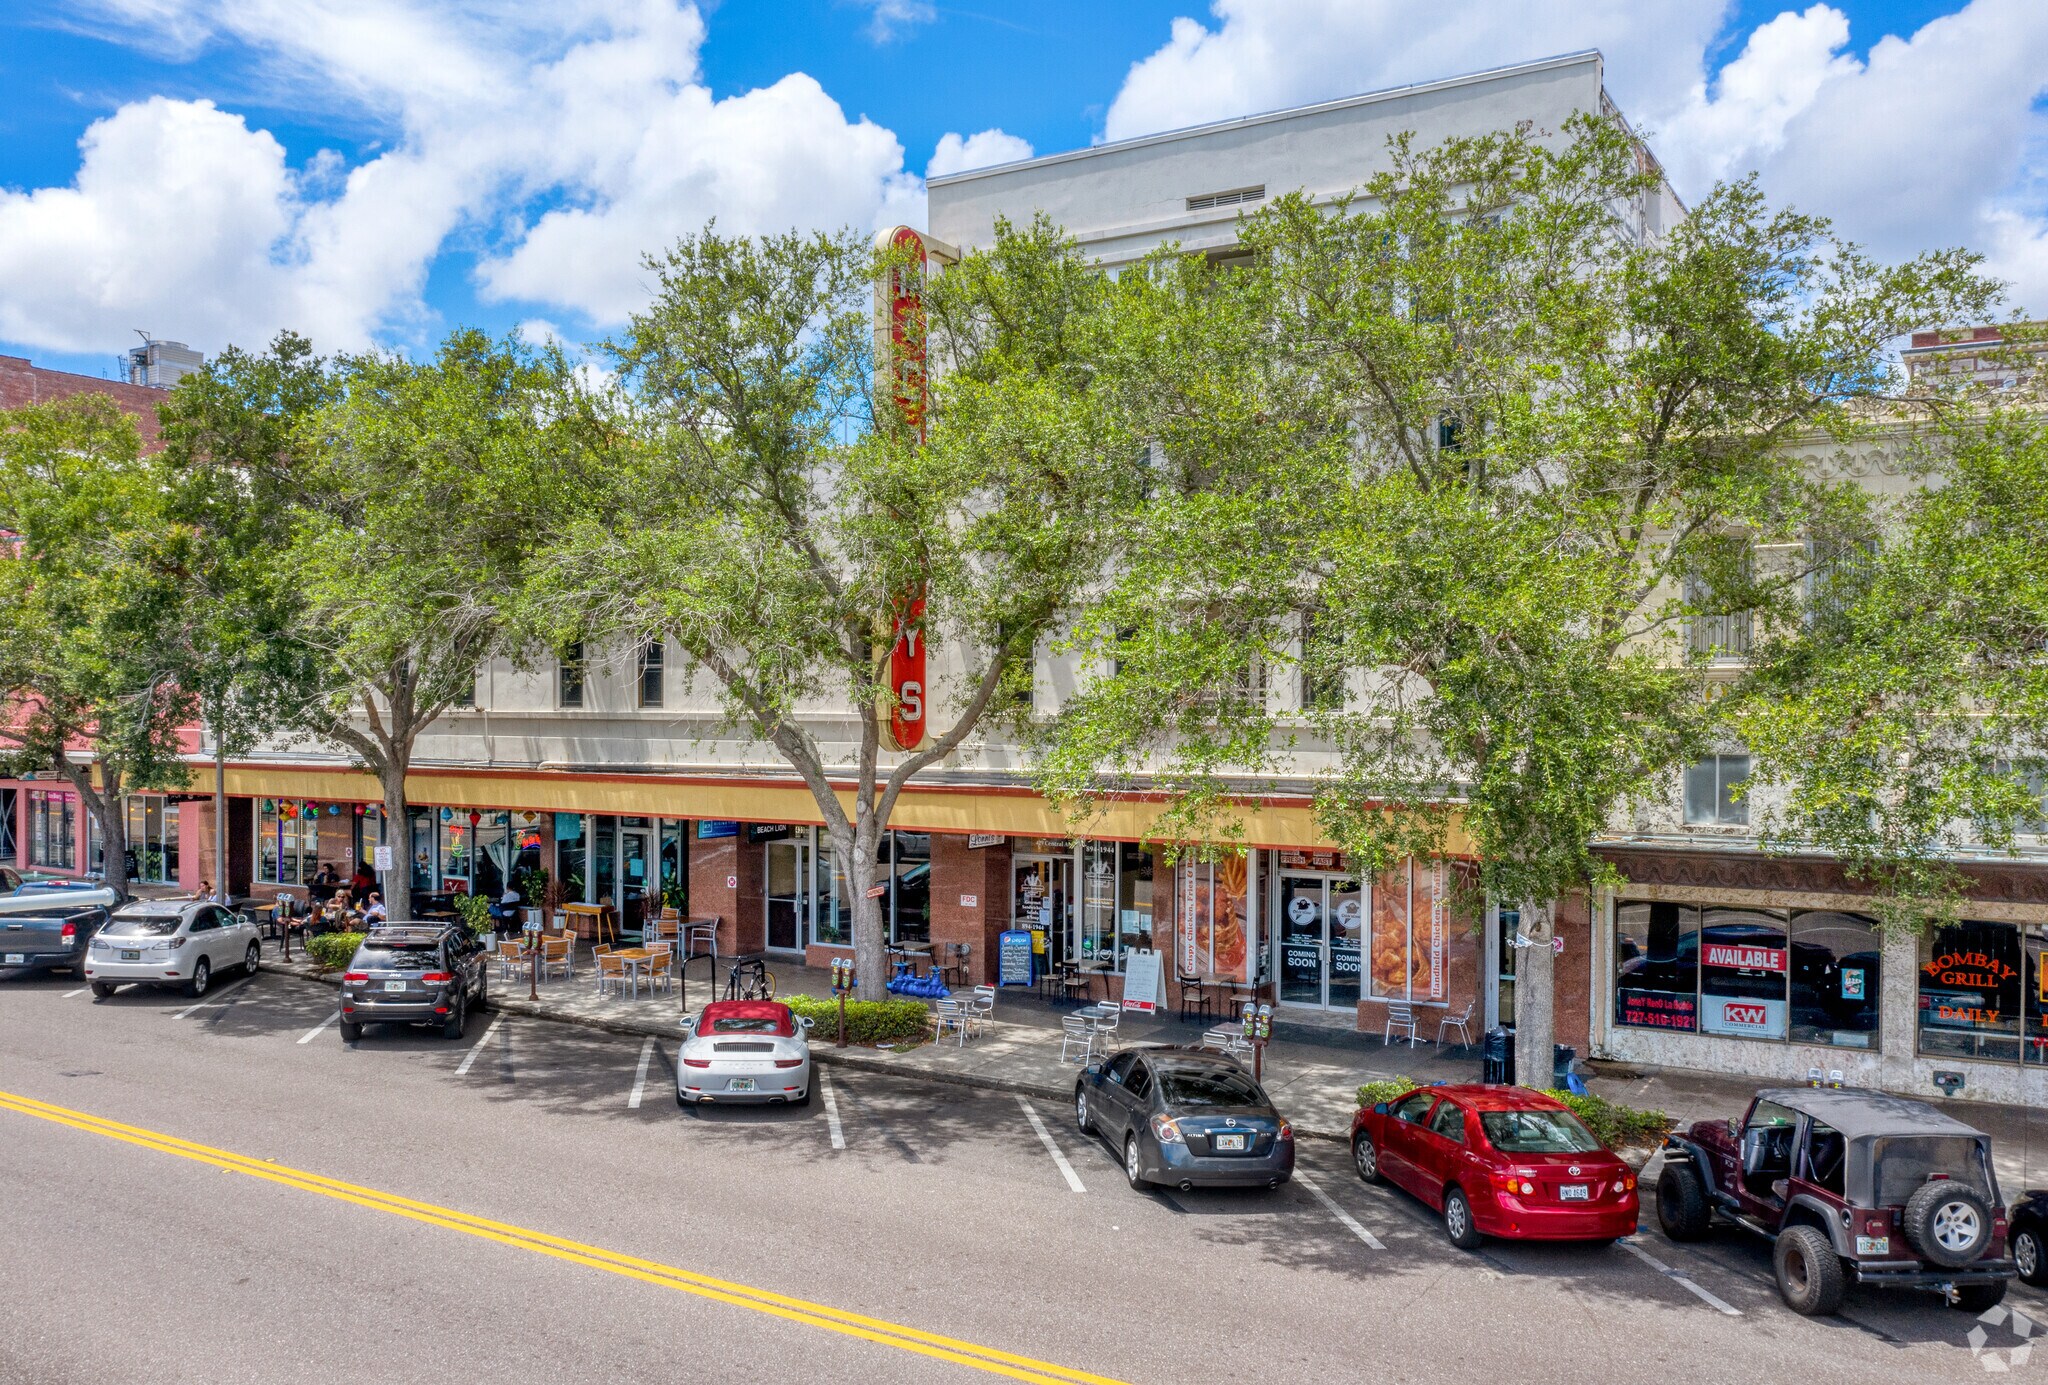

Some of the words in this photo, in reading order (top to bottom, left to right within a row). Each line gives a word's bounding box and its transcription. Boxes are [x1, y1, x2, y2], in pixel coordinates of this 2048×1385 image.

[756, 825, 774, 834] BEACH
[774, 824, 787, 832] LION
[1281, 856, 1305, 864] FRESH
[1187, 903, 1195, 941] Chicken,
[1432, 909, 1441, 948] Chicken
[1187, 943, 1195, 972] Crispy
[1288, 949, 1317, 958] COMING
[1336, 954, 1361, 963] COMIN
[1708, 947, 1779, 969] AVAILABLE
[1288, 958, 1316, 968] SOON
[1924, 952, 2018, 980] BOMBAY
[1432, 950, 1441, 995] Handheld
[1941, 971, 1999, 988] GRILL
[1725, 1006, 1765, 1023] KW
[1938, 1005, 2000, 1023] DAILY
[1724, 1022, 1765, 1030] COMMERCIAL
